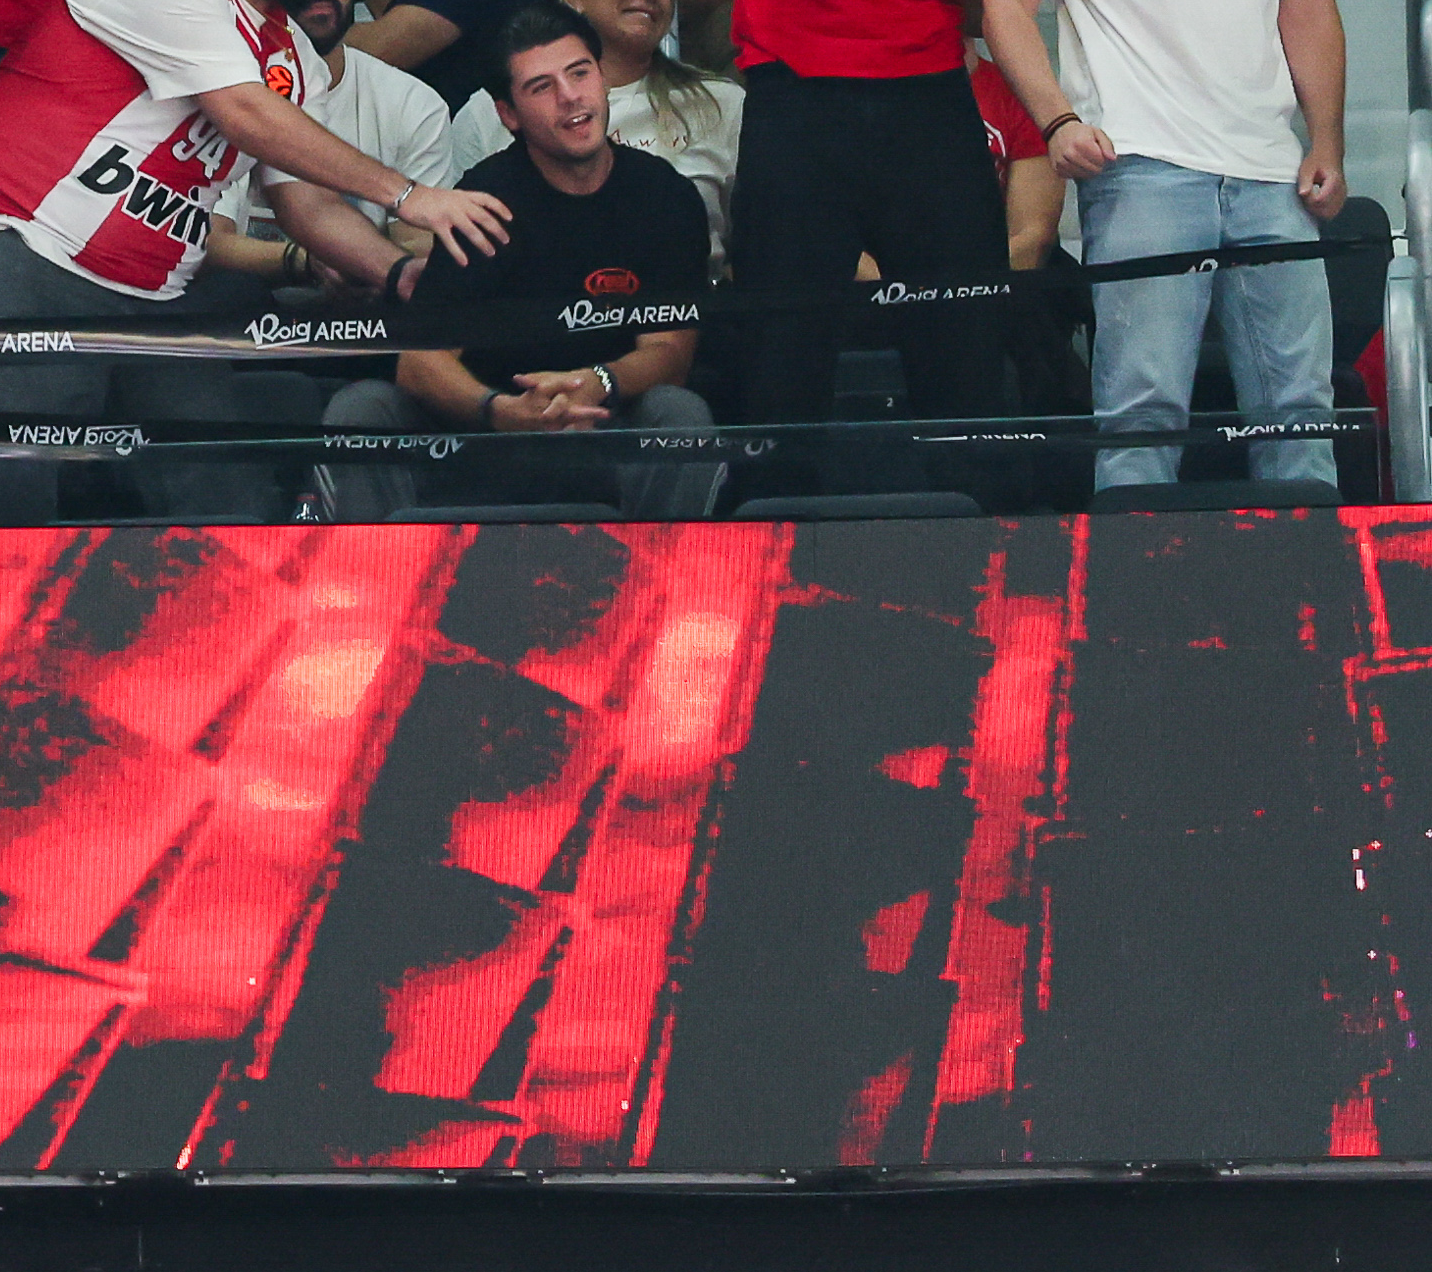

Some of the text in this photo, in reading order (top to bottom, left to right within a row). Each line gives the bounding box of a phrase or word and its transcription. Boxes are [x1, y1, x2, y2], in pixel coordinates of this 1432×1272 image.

[556, 299, 701, 332] Roig ARENA
[0, 330, 76, 354] ARENA
[243, 312, 389, 351] Roig ARENA
[7, 424, 83, 446] ARENA
